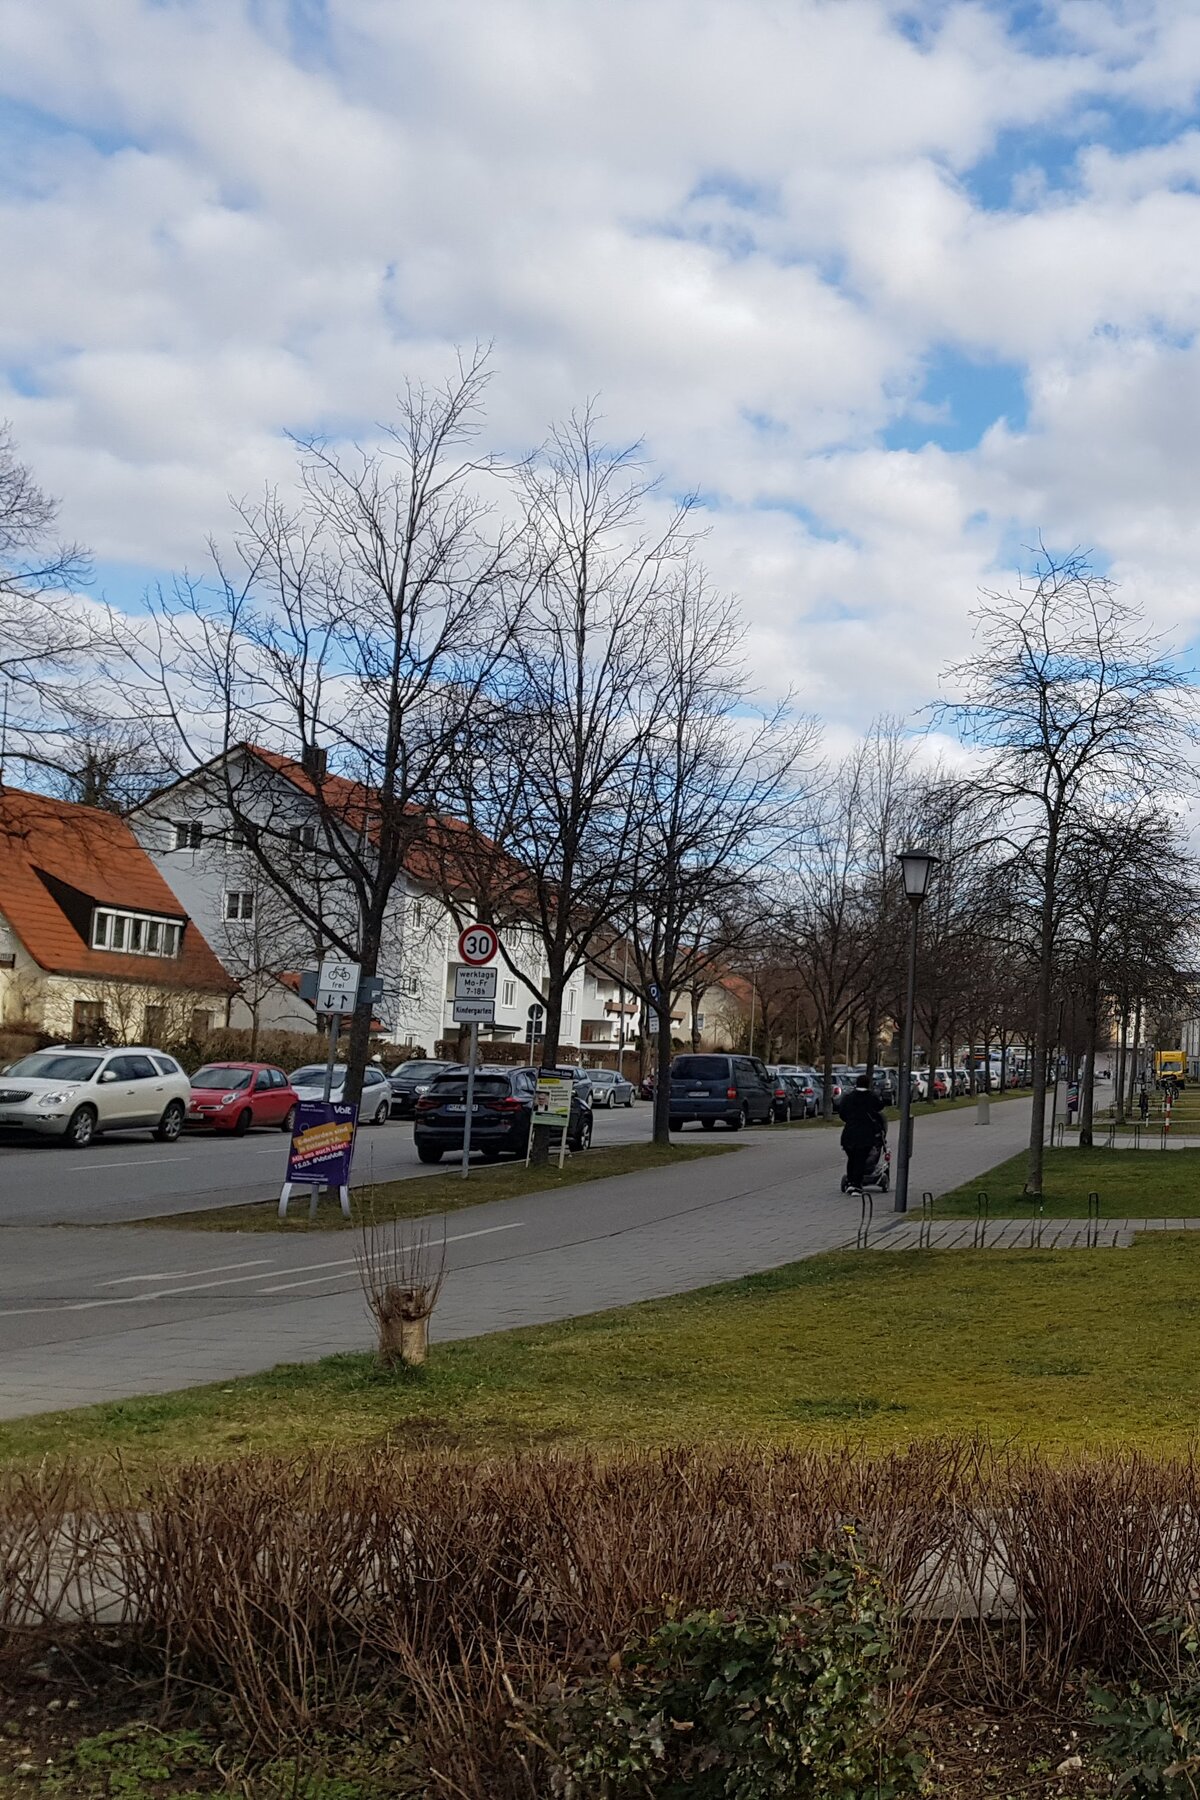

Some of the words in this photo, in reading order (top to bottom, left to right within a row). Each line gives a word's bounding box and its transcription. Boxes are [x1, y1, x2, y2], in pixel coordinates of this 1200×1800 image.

[466, 936, 490, 955] 30
[459, 971, 495, 980] werktags
[464, 979, 488, 987] Mo-Fr
[465, 987, 486, 995] 7-18h
[455, 1006, 492, 1015] Kindergarten
[333, 1105, 352, 1115] Volt
[291, 1154, 304, 1163] Mit
[315, 1147, 331, 1156] auch
